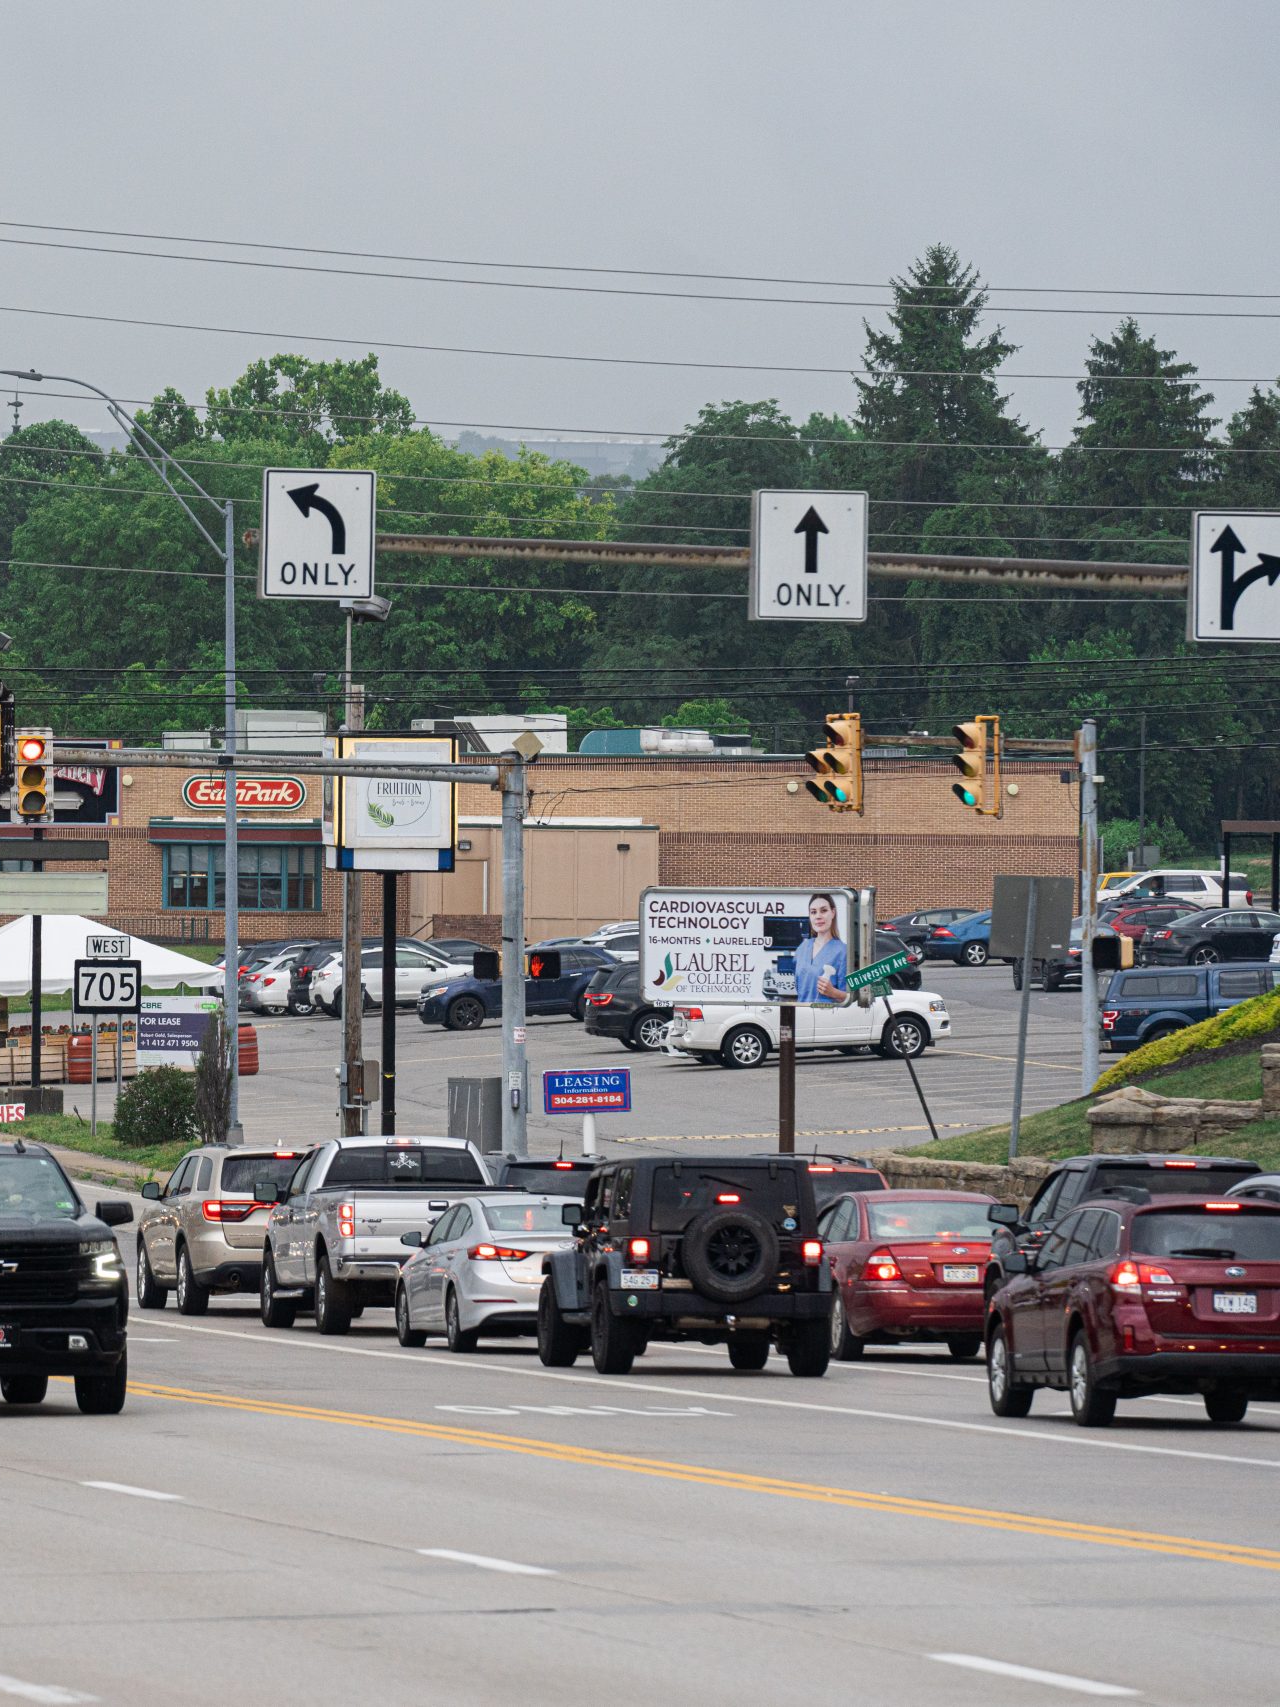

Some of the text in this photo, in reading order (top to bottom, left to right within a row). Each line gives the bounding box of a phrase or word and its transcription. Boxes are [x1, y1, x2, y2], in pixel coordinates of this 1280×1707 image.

[281, 562, 355, 585] ONLY
[777, 583, 845, 606] ONLY
[377, 782, 422, 795] FRUITION
[649, 900, 785, 915] CARDIOVASCULAR
[648, 916, 750, 929] TECHNOLOGY
[92, 940, 125, 954] WEST
[648, 935, 772, 946] 16-MONTHS LAUREL.EDU
[674, 952, 755, 972] LAUREL
[687, 972, 752, 985] COLLEGE
[847, 956, 907, 988] University Ave
[81, 972, 135, 1002] 705
[676, 985, 752, 994] OF TECHNOLOGY
[140, 1017, 181, 1026] FOR LEASE
[554, 1076, 620, 1087] LEASING
[554, 1095, 622, 1105] 304-281-8184
